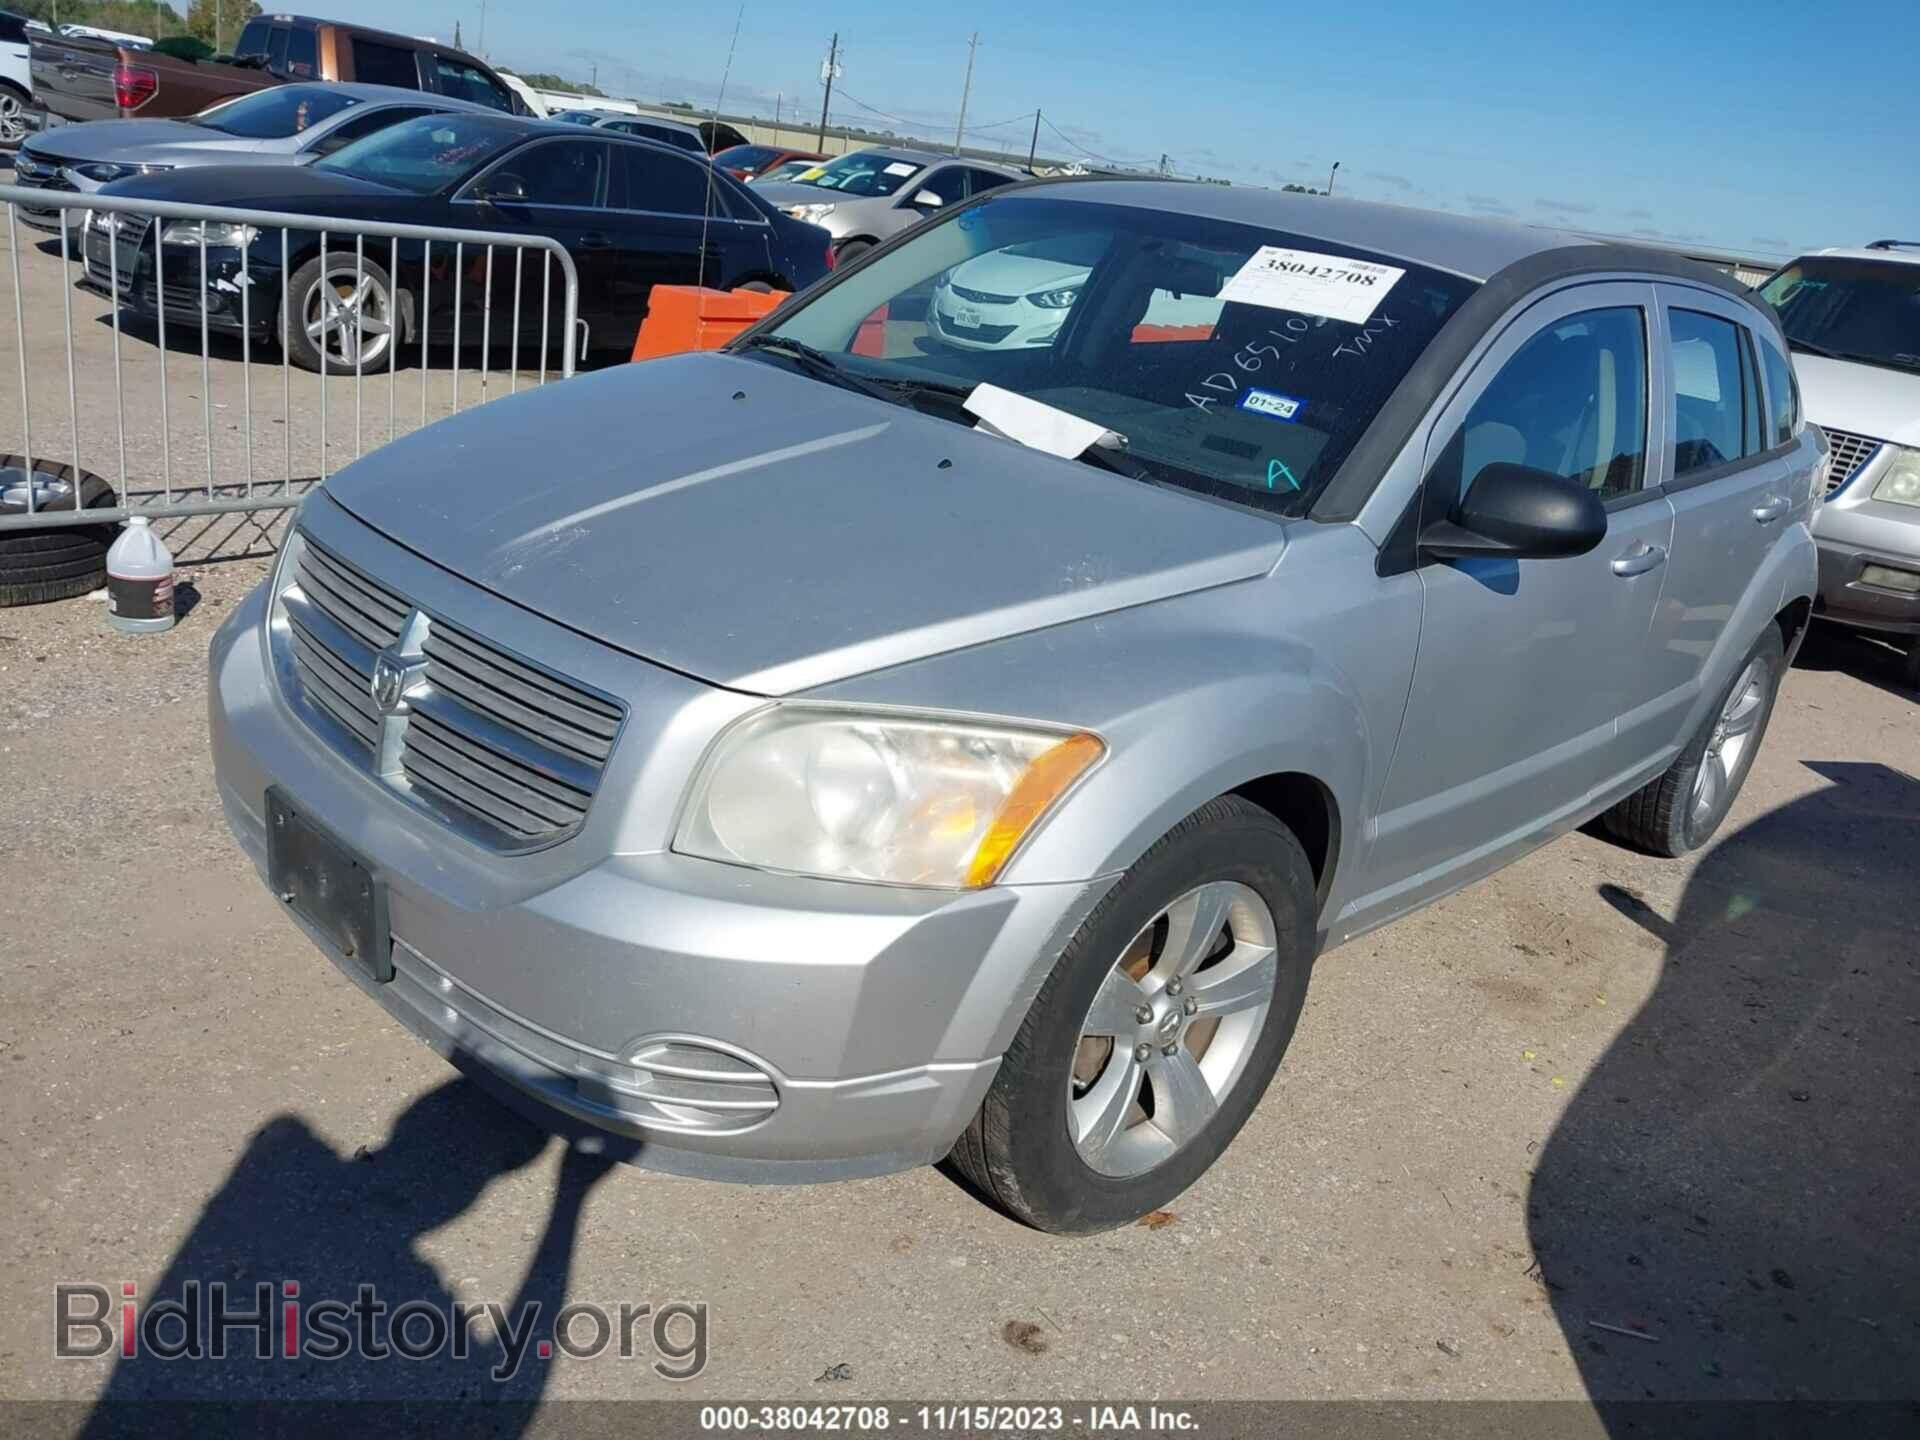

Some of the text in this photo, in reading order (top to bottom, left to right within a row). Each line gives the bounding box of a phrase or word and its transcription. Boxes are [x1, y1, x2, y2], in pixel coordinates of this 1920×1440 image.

[1260, 258, 1377, 286] 38042708
[1249, 395, 1294, 414] 01-24
[1267, 459, 1300, 490] A
